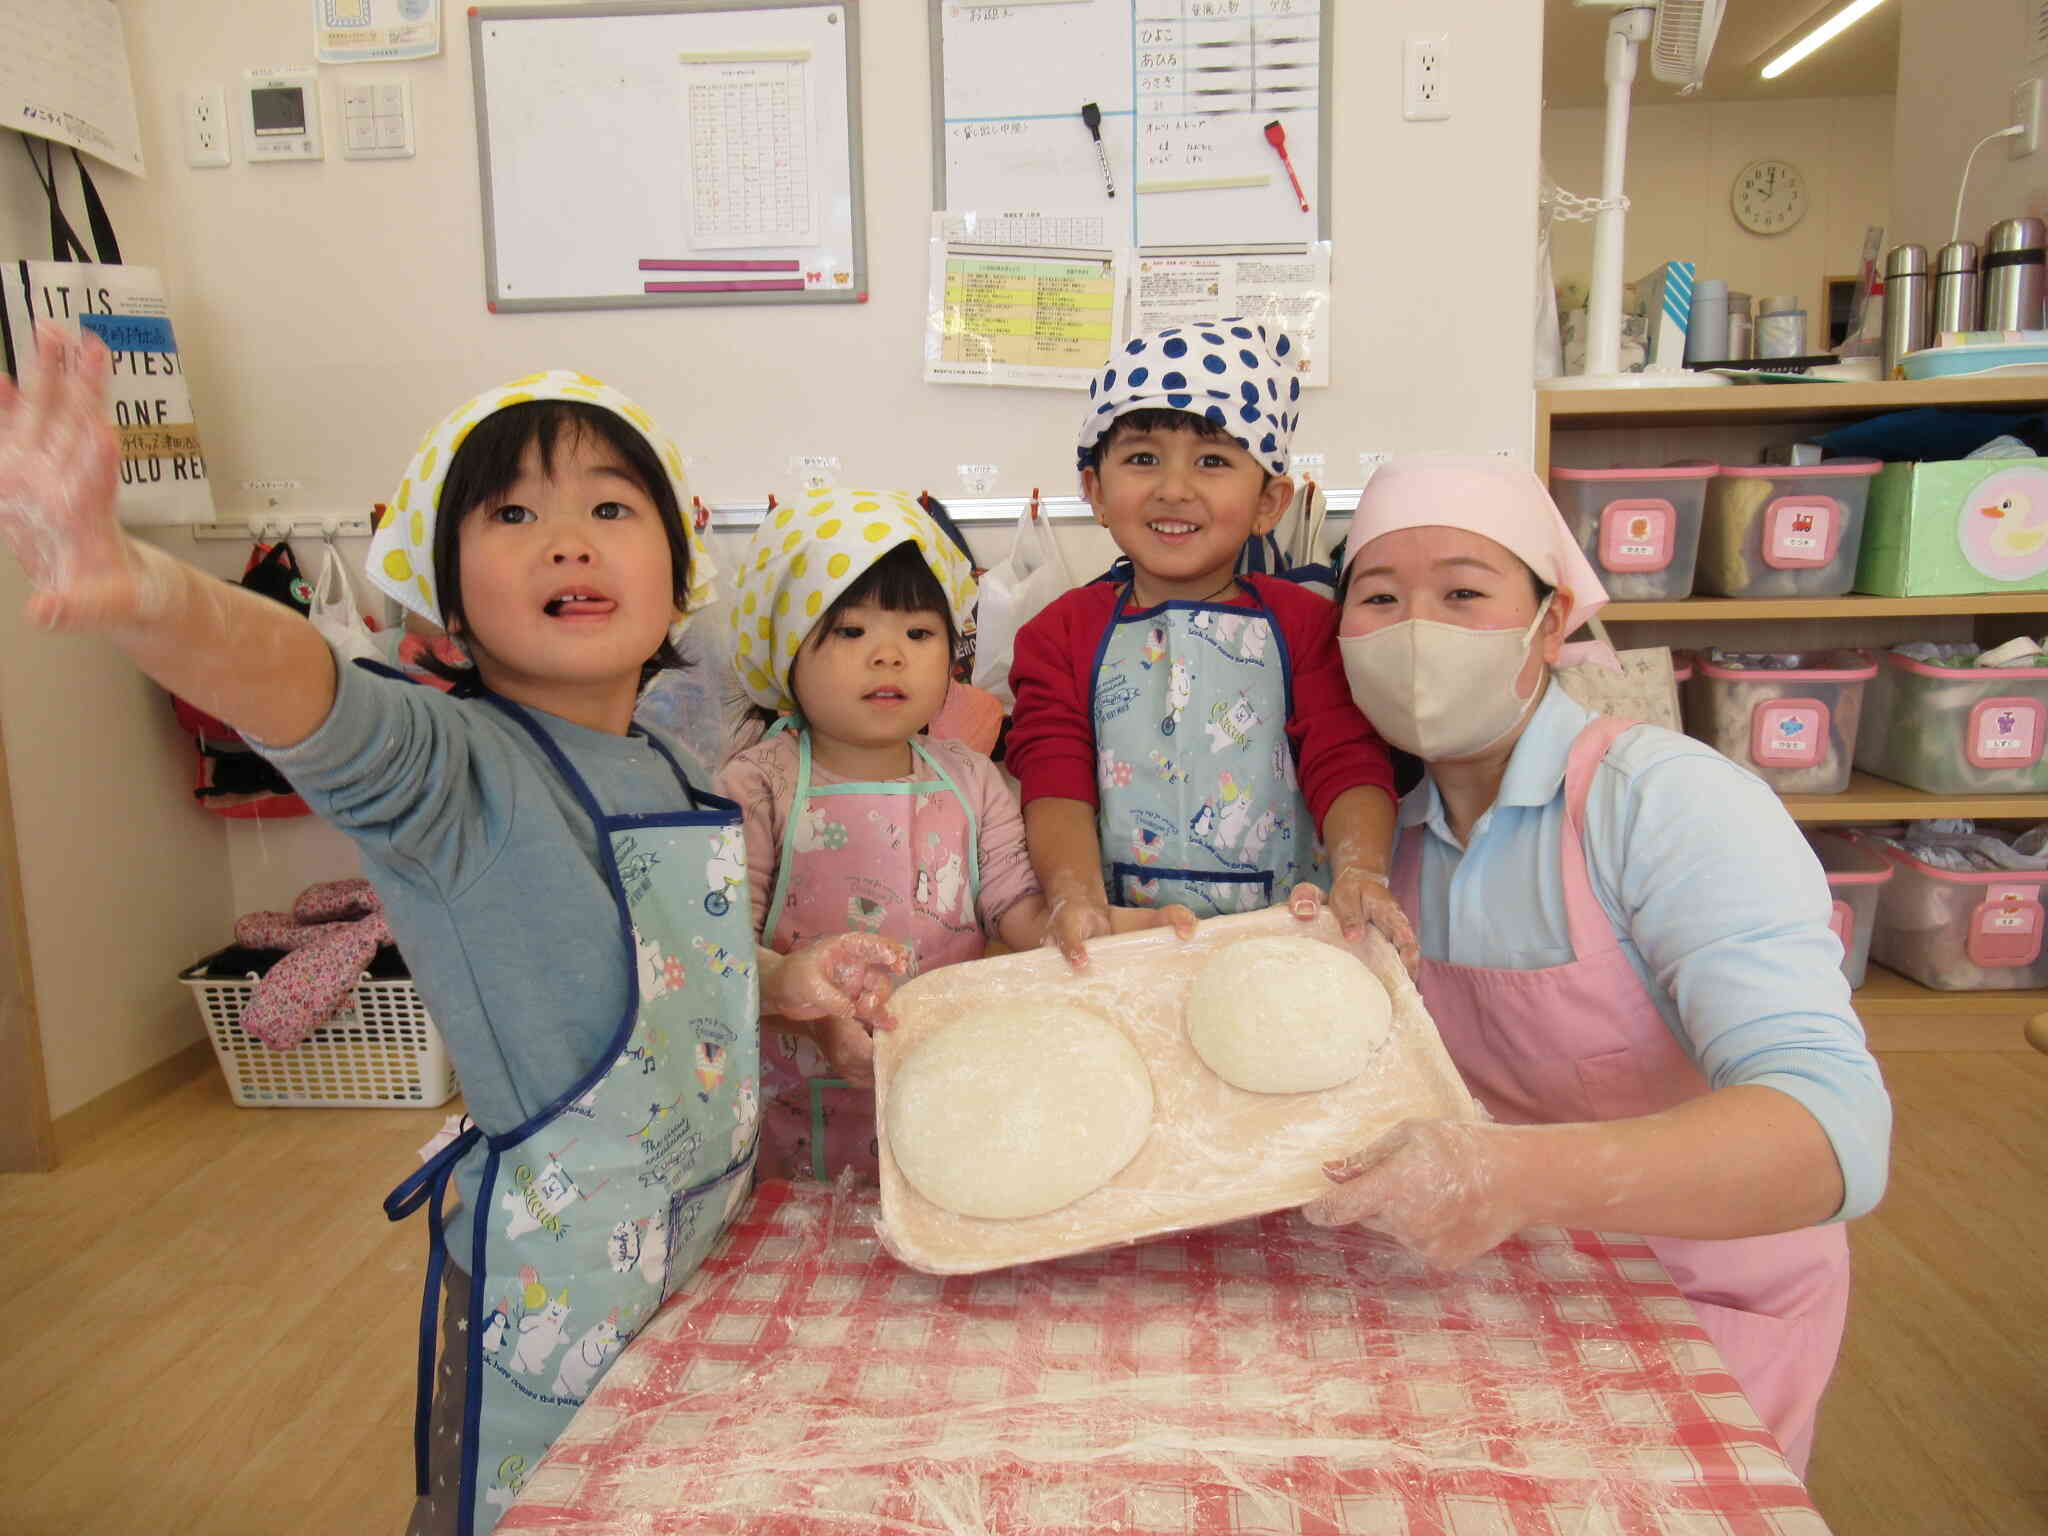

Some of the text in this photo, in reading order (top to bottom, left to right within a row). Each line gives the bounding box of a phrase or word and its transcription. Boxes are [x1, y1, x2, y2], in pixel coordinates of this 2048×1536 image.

[1142, 28, 1173, 43] ひよこ
[1141, 53, 1177, 68] あひる
[1142, 76, 1175, 88] うさぎ
[44, 286, 70, 318] IT
[86, 288, 113, 315] IS
[115, 400, 168, 430] ONE
[715, 948, 727, 961] N
[721, 965, 733, 978] E
